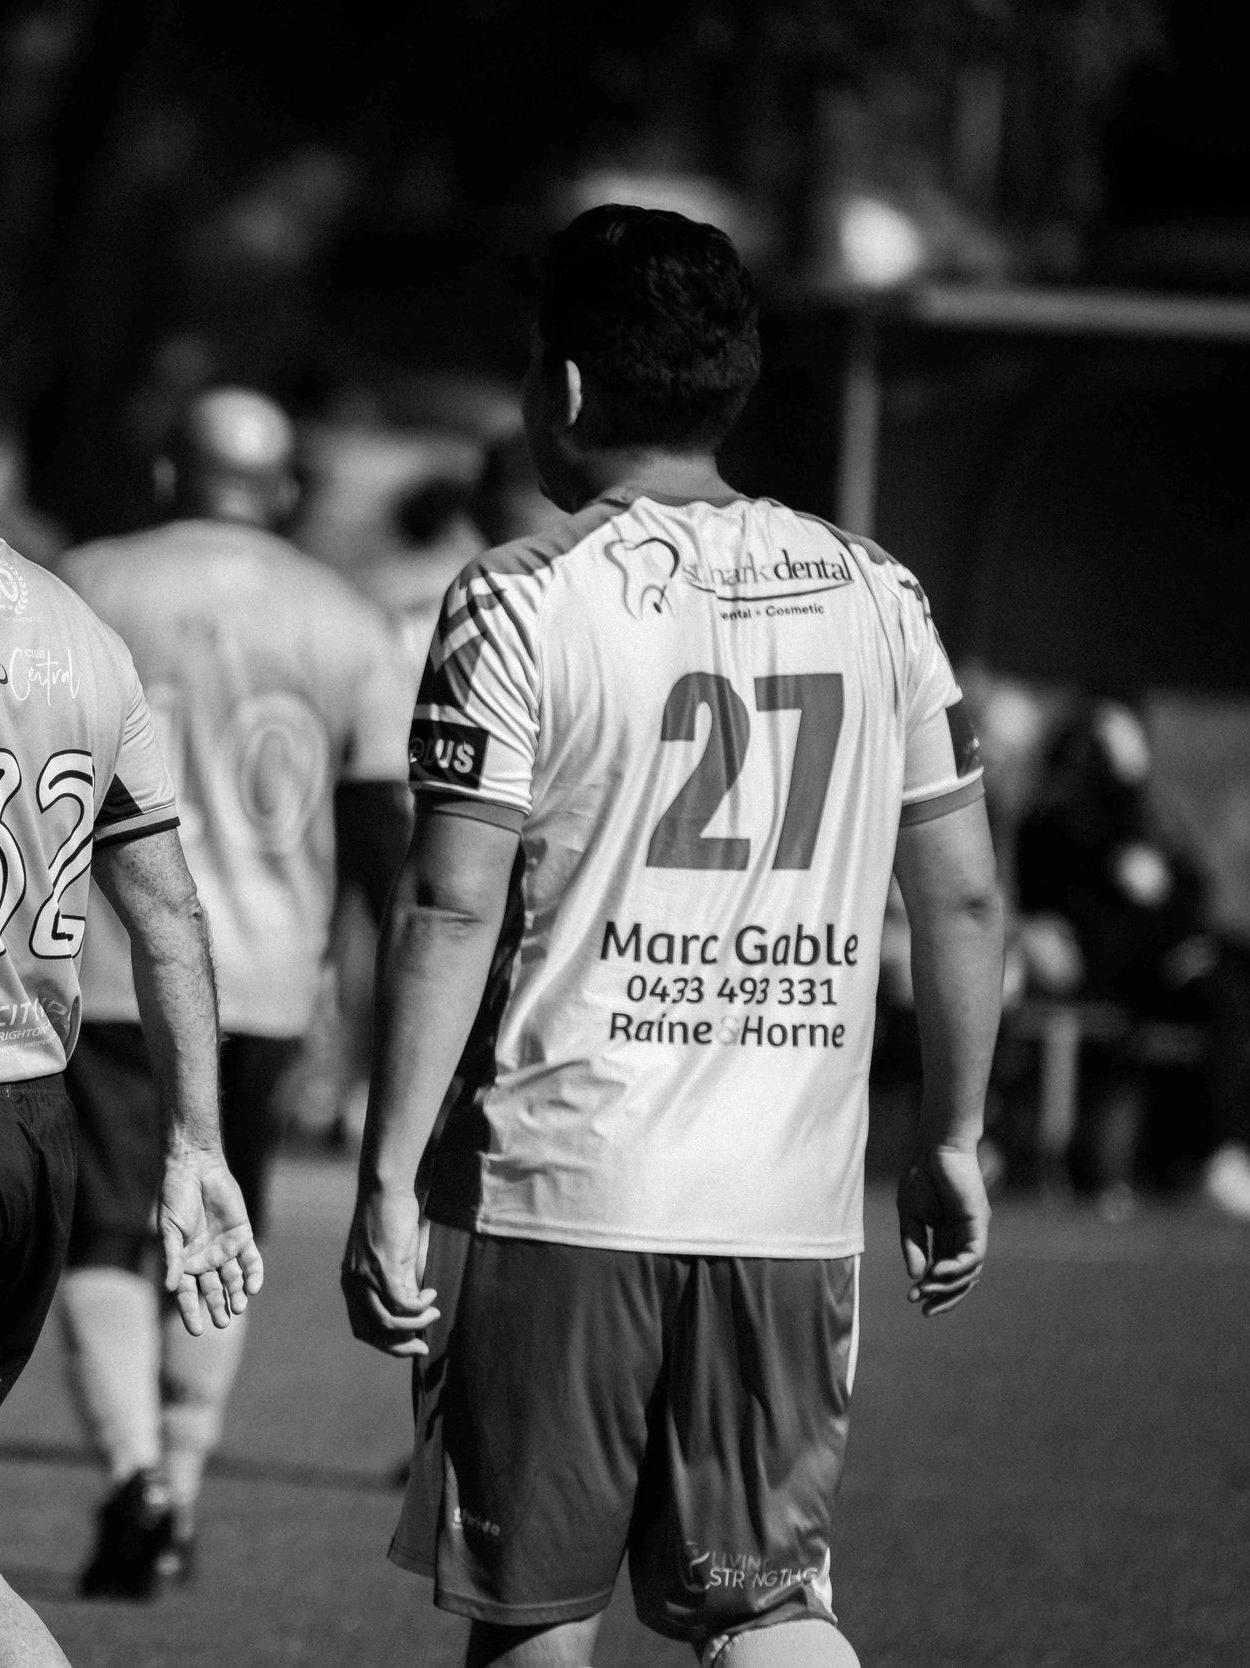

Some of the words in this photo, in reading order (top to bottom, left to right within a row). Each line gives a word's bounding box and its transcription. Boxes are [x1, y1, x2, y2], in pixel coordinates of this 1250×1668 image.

[773, 548, 853, 582] dental
[720, 607, 752, 621] ental
[765, 603, 825, 618] Cosmetic
[9, 648, 81, 707] Central
[646, 671, 843, 871] 27
[600, 920, 720, 966] Marc
[734, 923, 859, 967] Gable
[627, 974, 704, 1004] 0433
[717, 976, 771, 1005] 493
[778, 978, 838, 1006] 331
[610, 1012, 713, 1045] Raine
[740, 1016, 846, 1049] Horne
